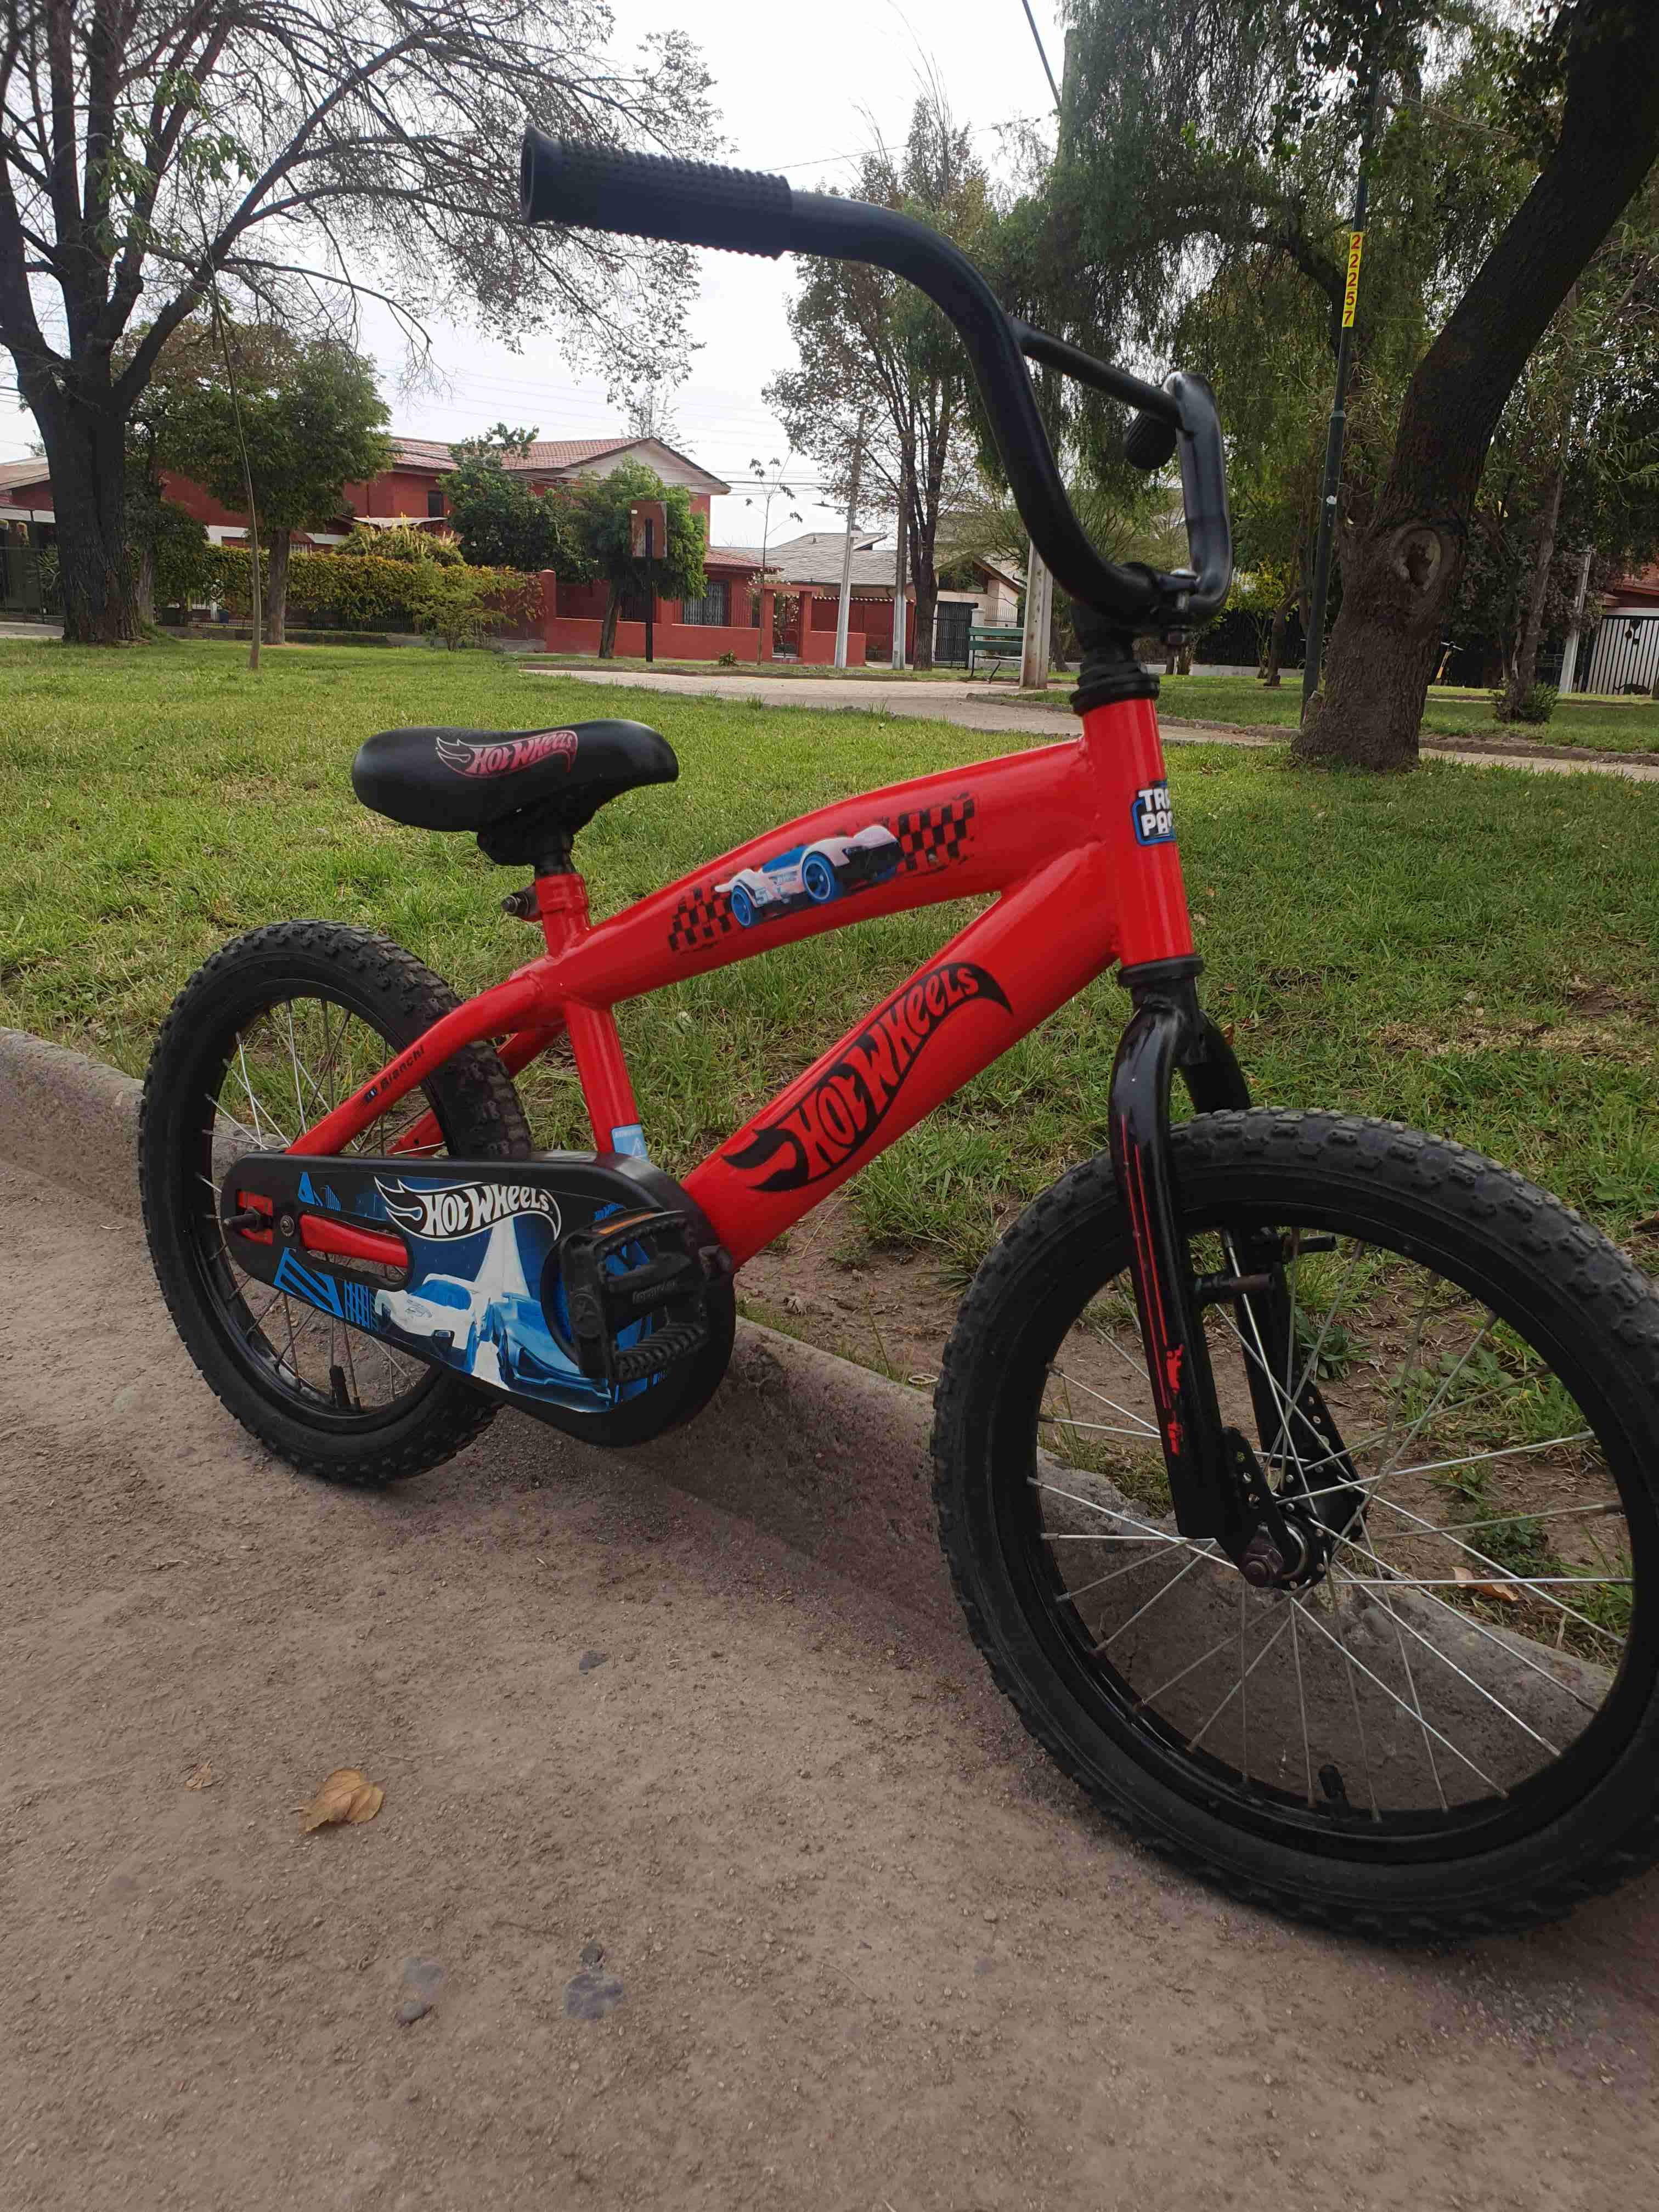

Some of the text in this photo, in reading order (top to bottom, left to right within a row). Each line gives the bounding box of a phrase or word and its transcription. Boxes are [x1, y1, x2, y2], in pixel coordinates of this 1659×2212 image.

[1344, 234, 1361, 325] 22257
[466, 746, 514, 774] HOT
[787, 1074, 868, 1179] HOT
[415, 1193, 470, 1236] HOT
